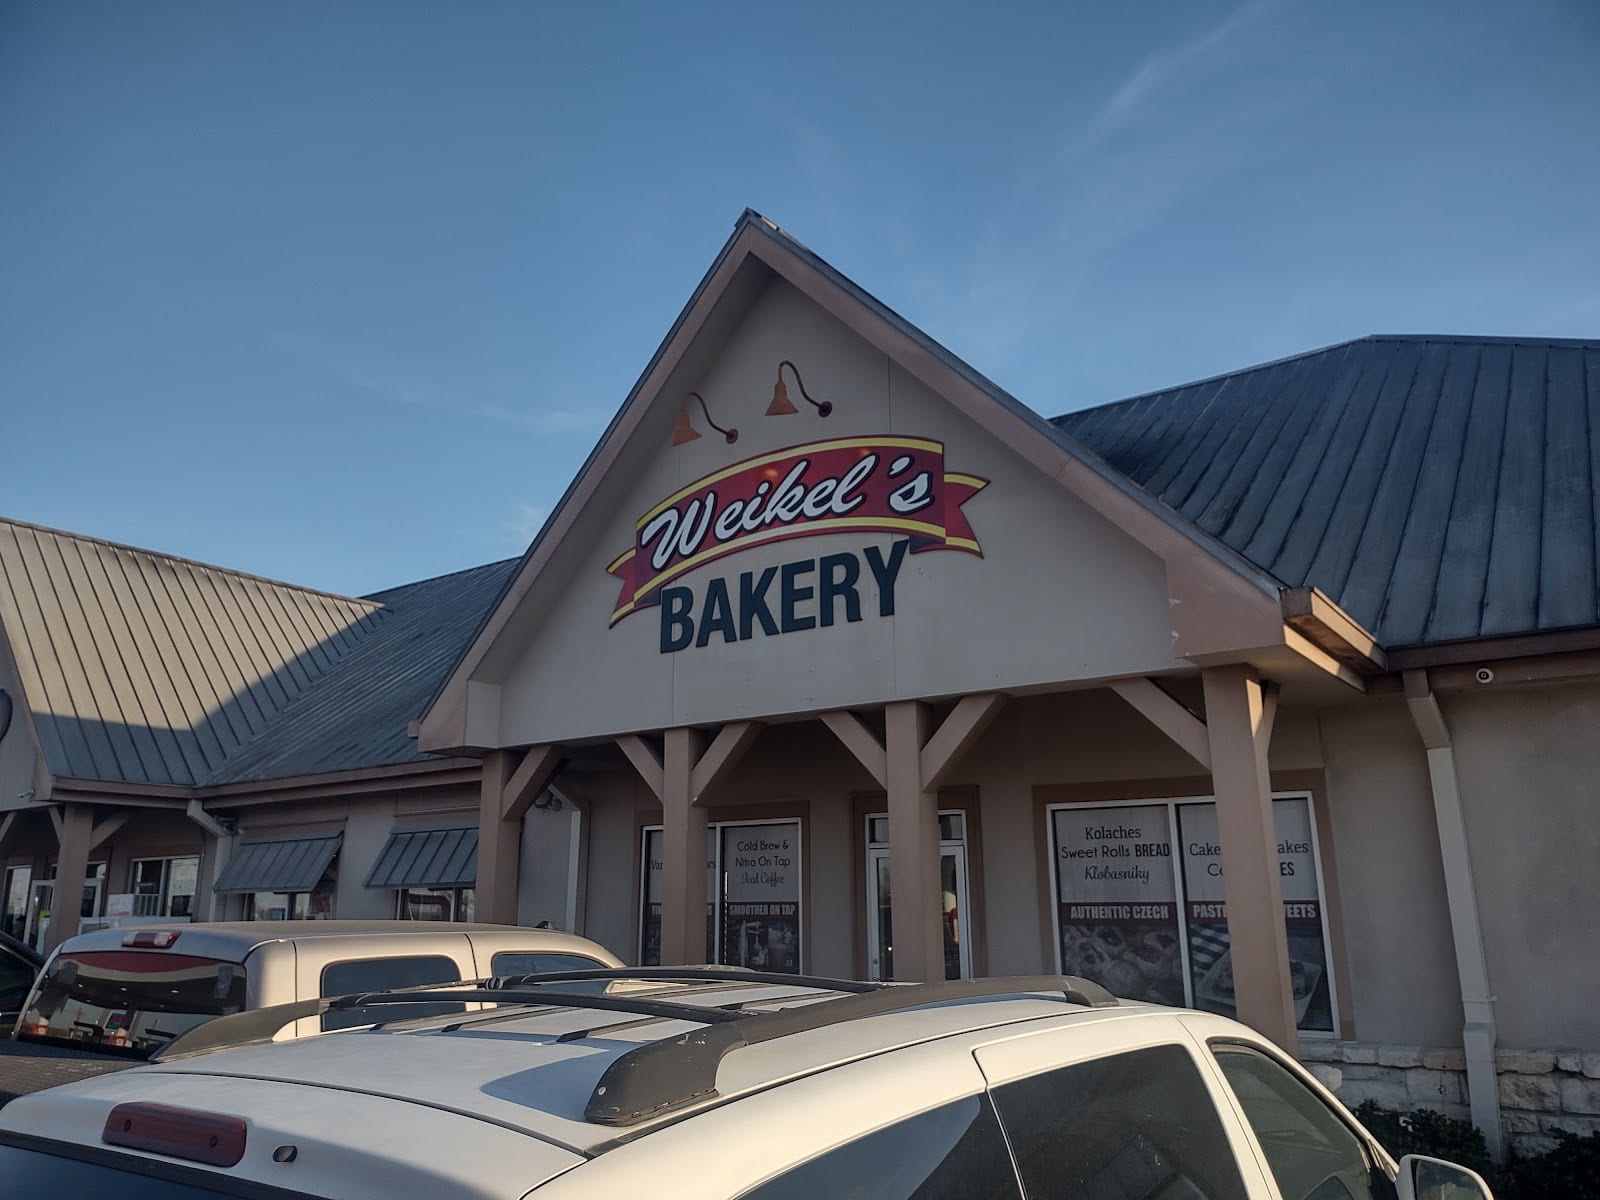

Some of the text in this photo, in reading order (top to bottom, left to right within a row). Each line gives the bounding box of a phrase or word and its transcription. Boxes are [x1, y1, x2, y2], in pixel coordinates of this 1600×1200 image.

[640, 454, 932, 569] Weikel's
[660, 540, 909, 654] BAKERY
[1085, 825, 1142, 840] Kolaches
[737, 839, 789, 851] Cold Brew &
[1061, 843, 1170, 859] Sweet Rolls BREAD
[1189, 840, 1309, 856] Cake akes
[735, 856, 791, 869] Nitro On Tap
[760, 871, 785, 888] Coffee
[1084, 865, 1150, 885] Klobasniky
[729, 904, 796, 916] SMOOTHER ON TAP
[1070, 905, 1169, 919] AUTHENTIC CZECH
[1193, 904, 1227, 918] PAST
